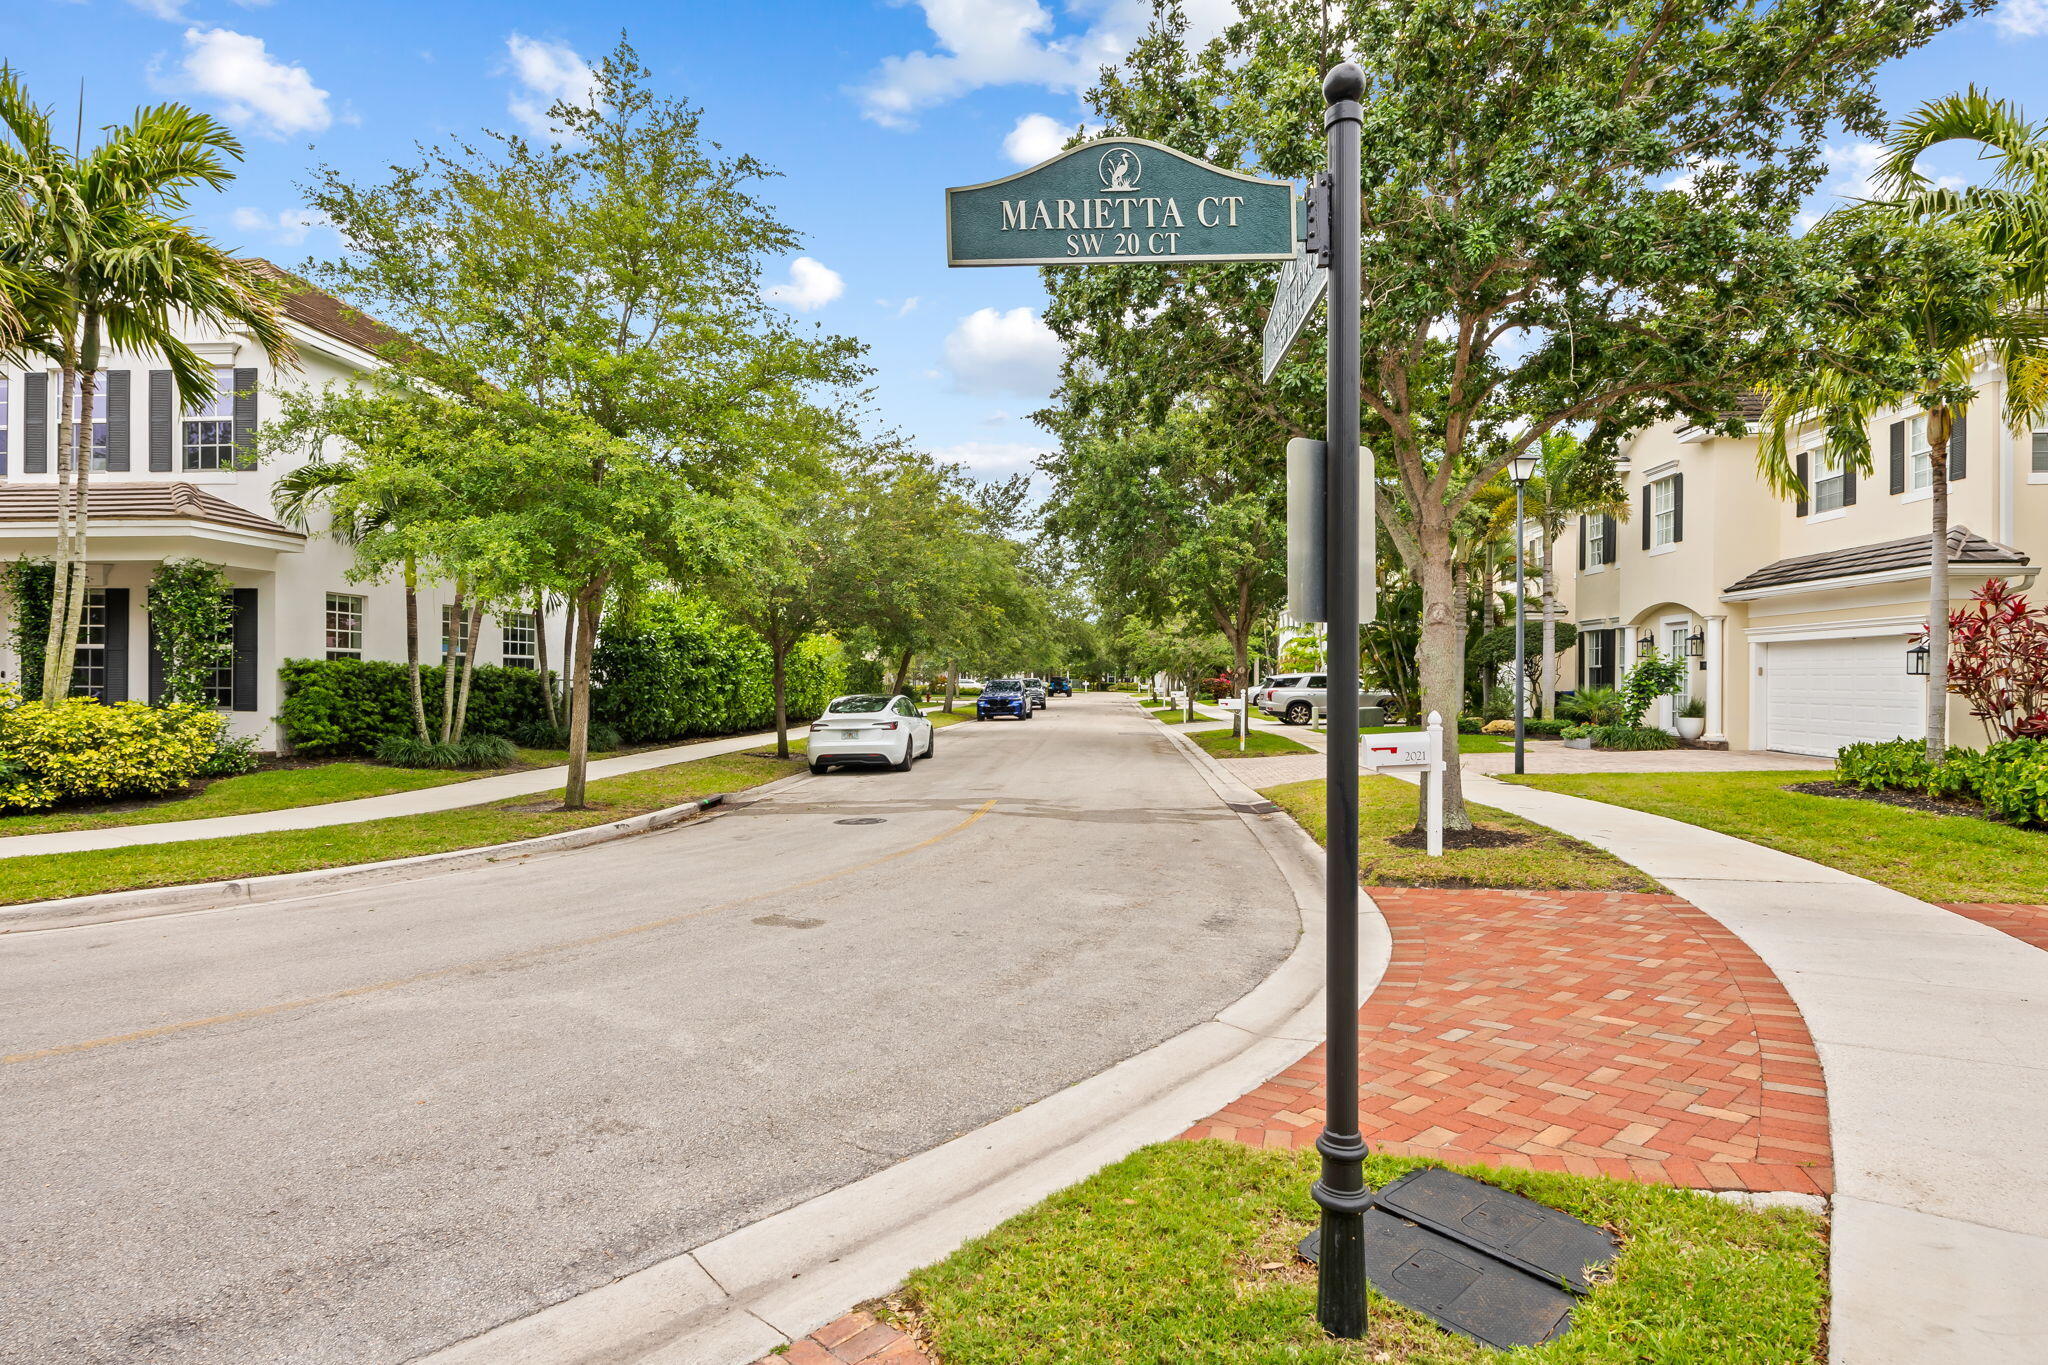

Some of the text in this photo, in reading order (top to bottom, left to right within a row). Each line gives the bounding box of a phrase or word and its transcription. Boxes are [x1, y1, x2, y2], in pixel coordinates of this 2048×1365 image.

[1000, 196, 1245, 230] MARIETTA CT
[1066, 232, 1181, 256] SW 20 CT
[1405, 751, 1426, 761] 2021
